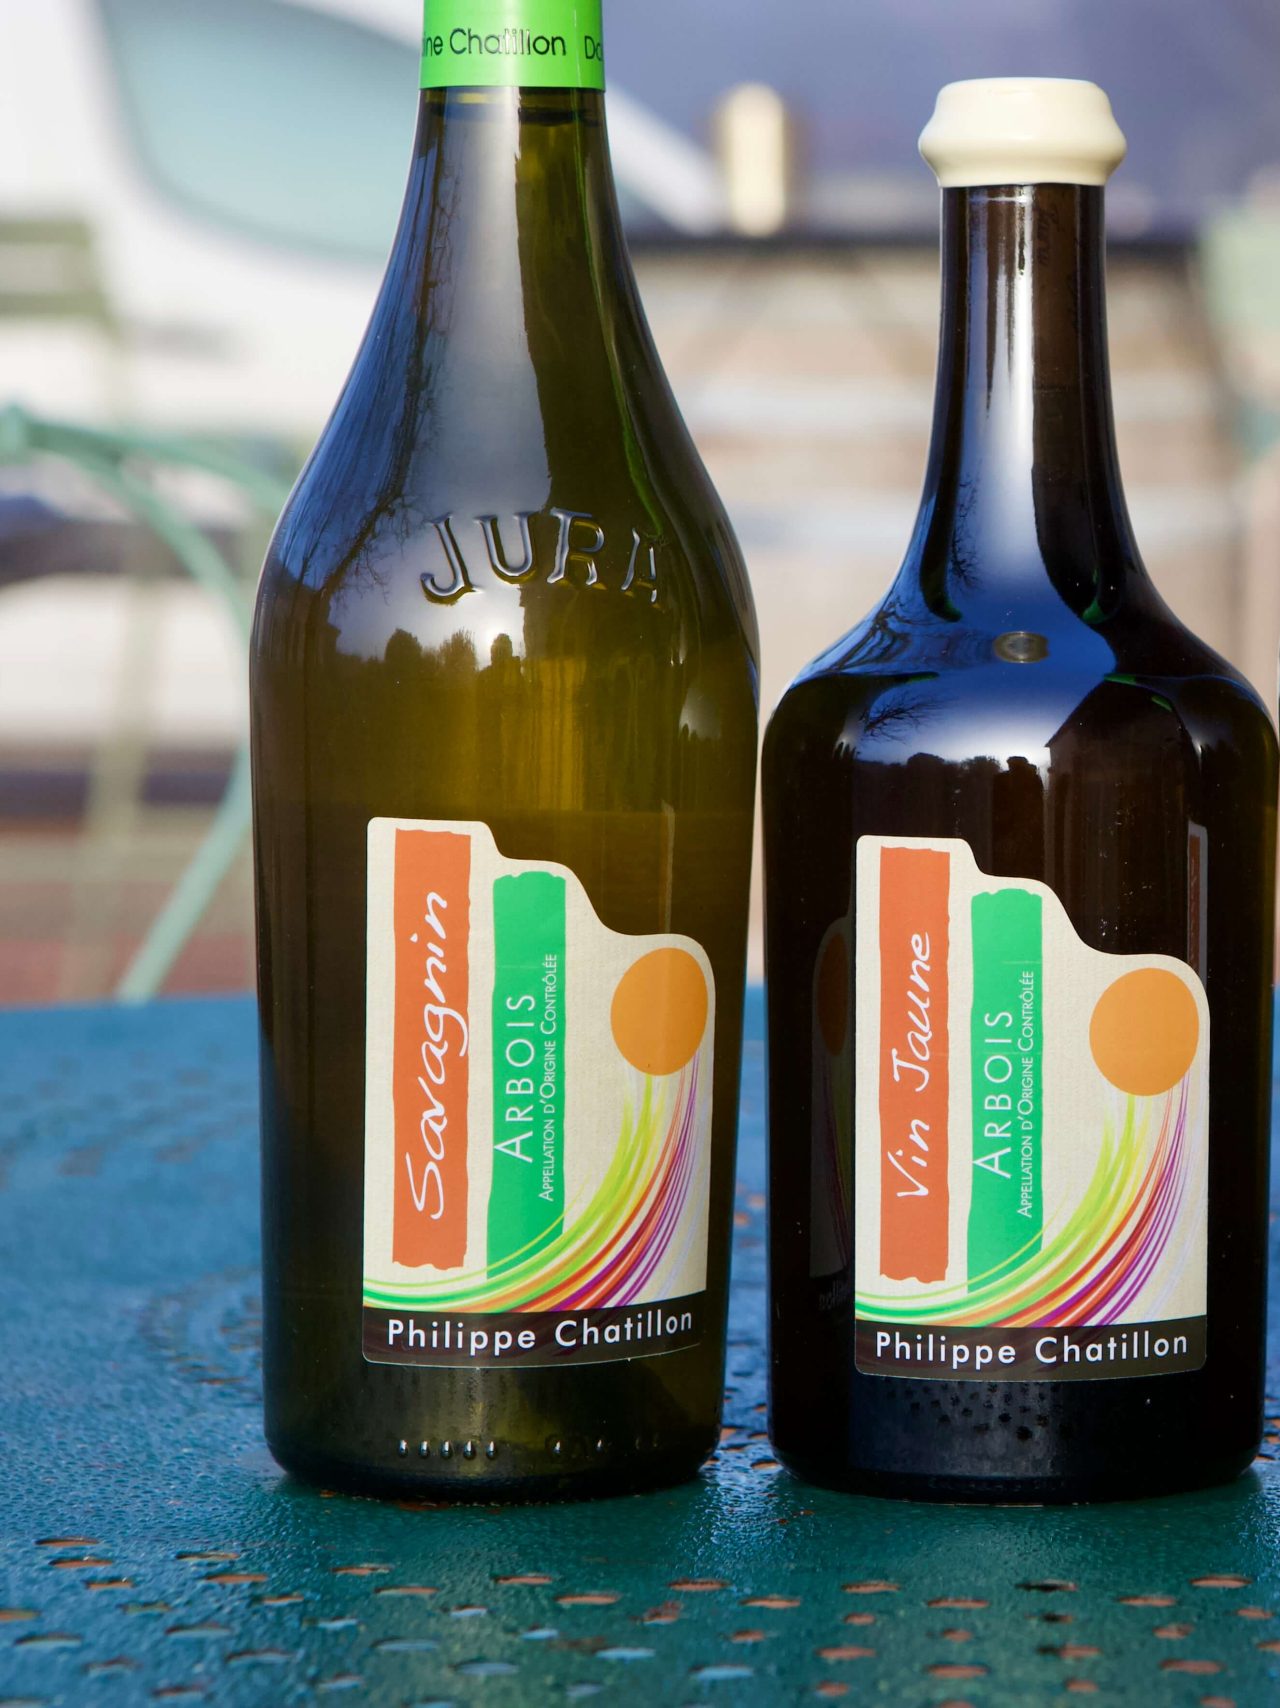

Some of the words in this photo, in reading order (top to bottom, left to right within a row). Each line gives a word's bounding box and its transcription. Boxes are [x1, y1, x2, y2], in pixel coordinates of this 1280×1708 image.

[450, 28, 566, 56] Chatillon
[421, 508, 658, 605] JURA
[540, 954, 558, 1034] CONTRÔLÉE
[891, 932, 931, 1092] Jaune
[1017, 971, 1034, 1052] CONTRÔLÉE
[406, 891, 468, 1220] Savagnin
[494, 995, 535, 1163] ARBOIS
[974, 1011, 1012, 1178] ARBOIS
[539, 1119, 555, 1201] APPELLATION
[888, 1121, 930, 1197] Vin
[1017, 1135, 1032, 1218] APPELLATION
[388, 1320, 536, 1356] Philippe
[555, 1312, 692, 1347] Chatillon
[876, 1332, 1016, 1369] Philippe
[1035, 1331, 1188, 1364] Chatillon
